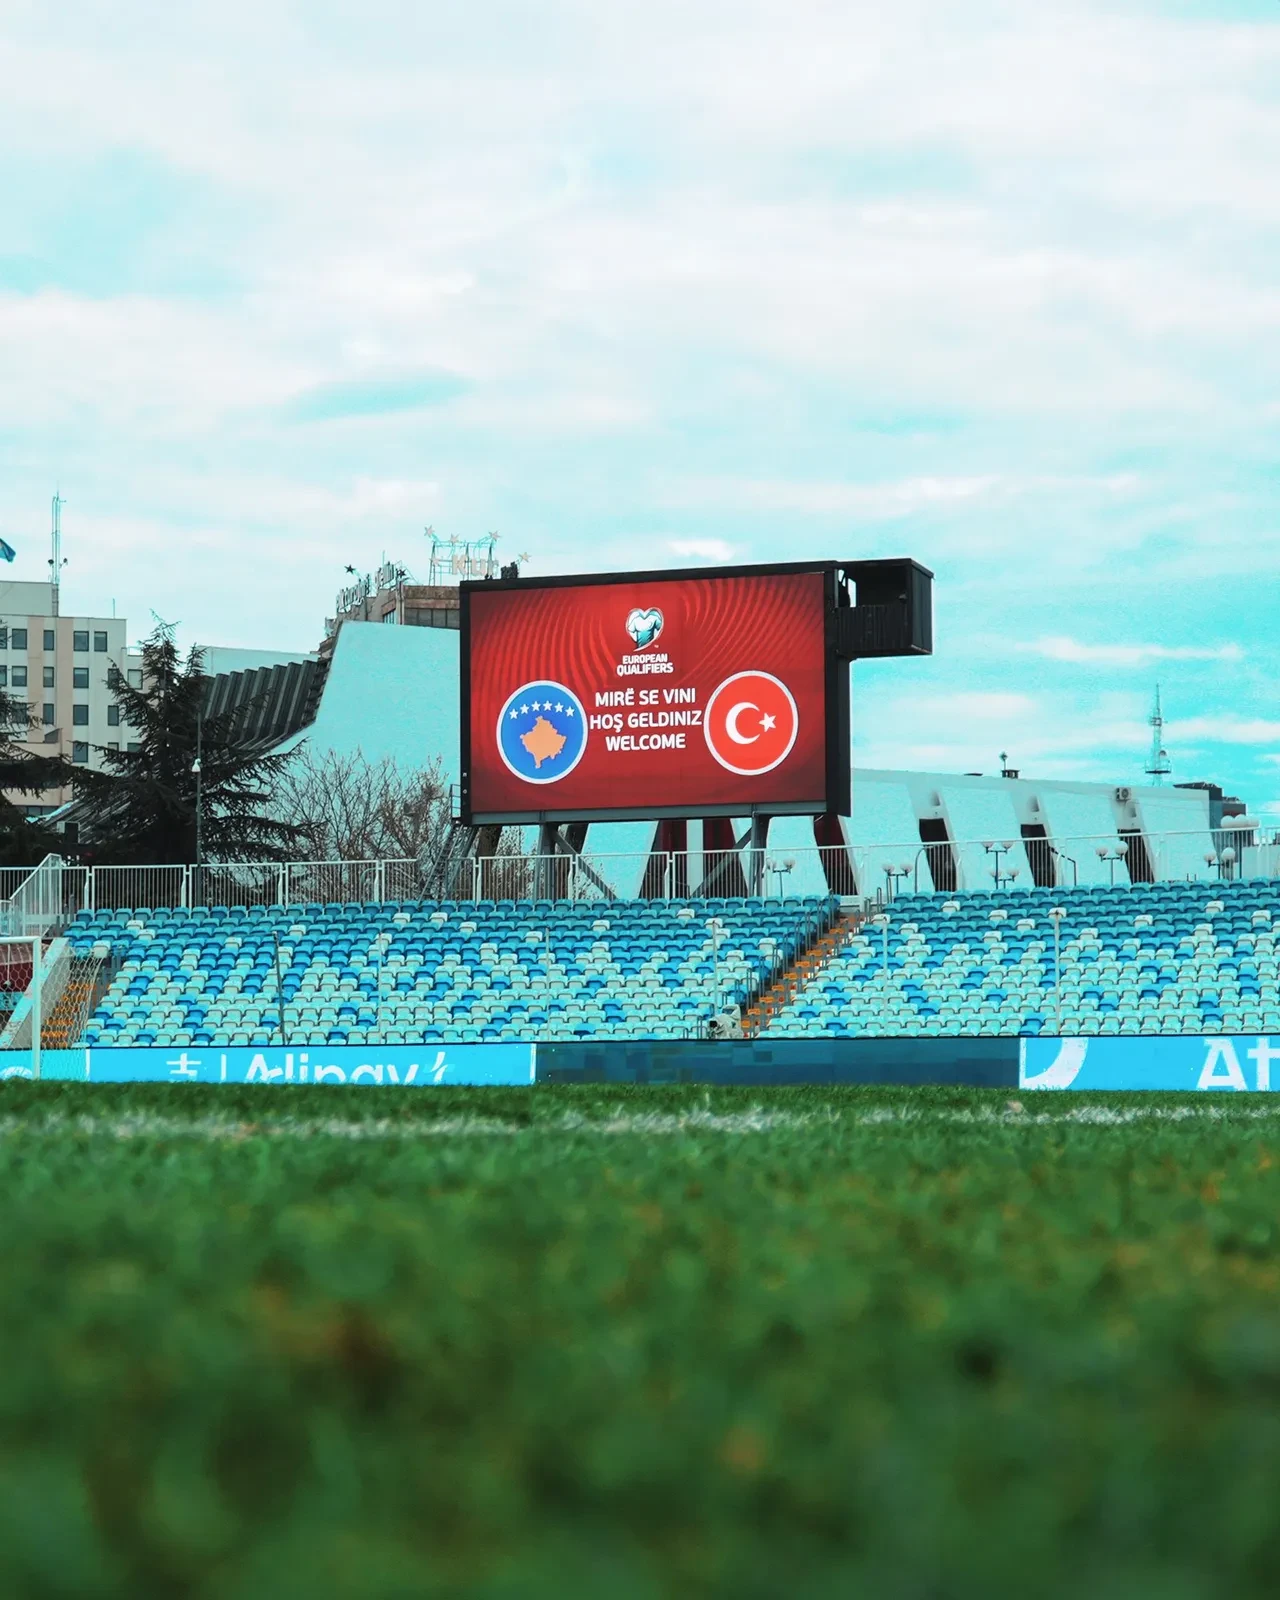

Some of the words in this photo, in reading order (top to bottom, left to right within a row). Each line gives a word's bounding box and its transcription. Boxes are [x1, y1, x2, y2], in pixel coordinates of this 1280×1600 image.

[622, 653, 668, 664] EUROPEAN
[616, 662, 674, 677] QUALIFIERS
[595, 687, 635, 707] MIRË
[638, 689, 659, 705] SE
[663, 687, 696, 704] VINI
[589, 713, 624, 733] HOŞ
[627, 710, 702, 728] GELDINIZ
[605, 733, 686, 751] WELCOME
